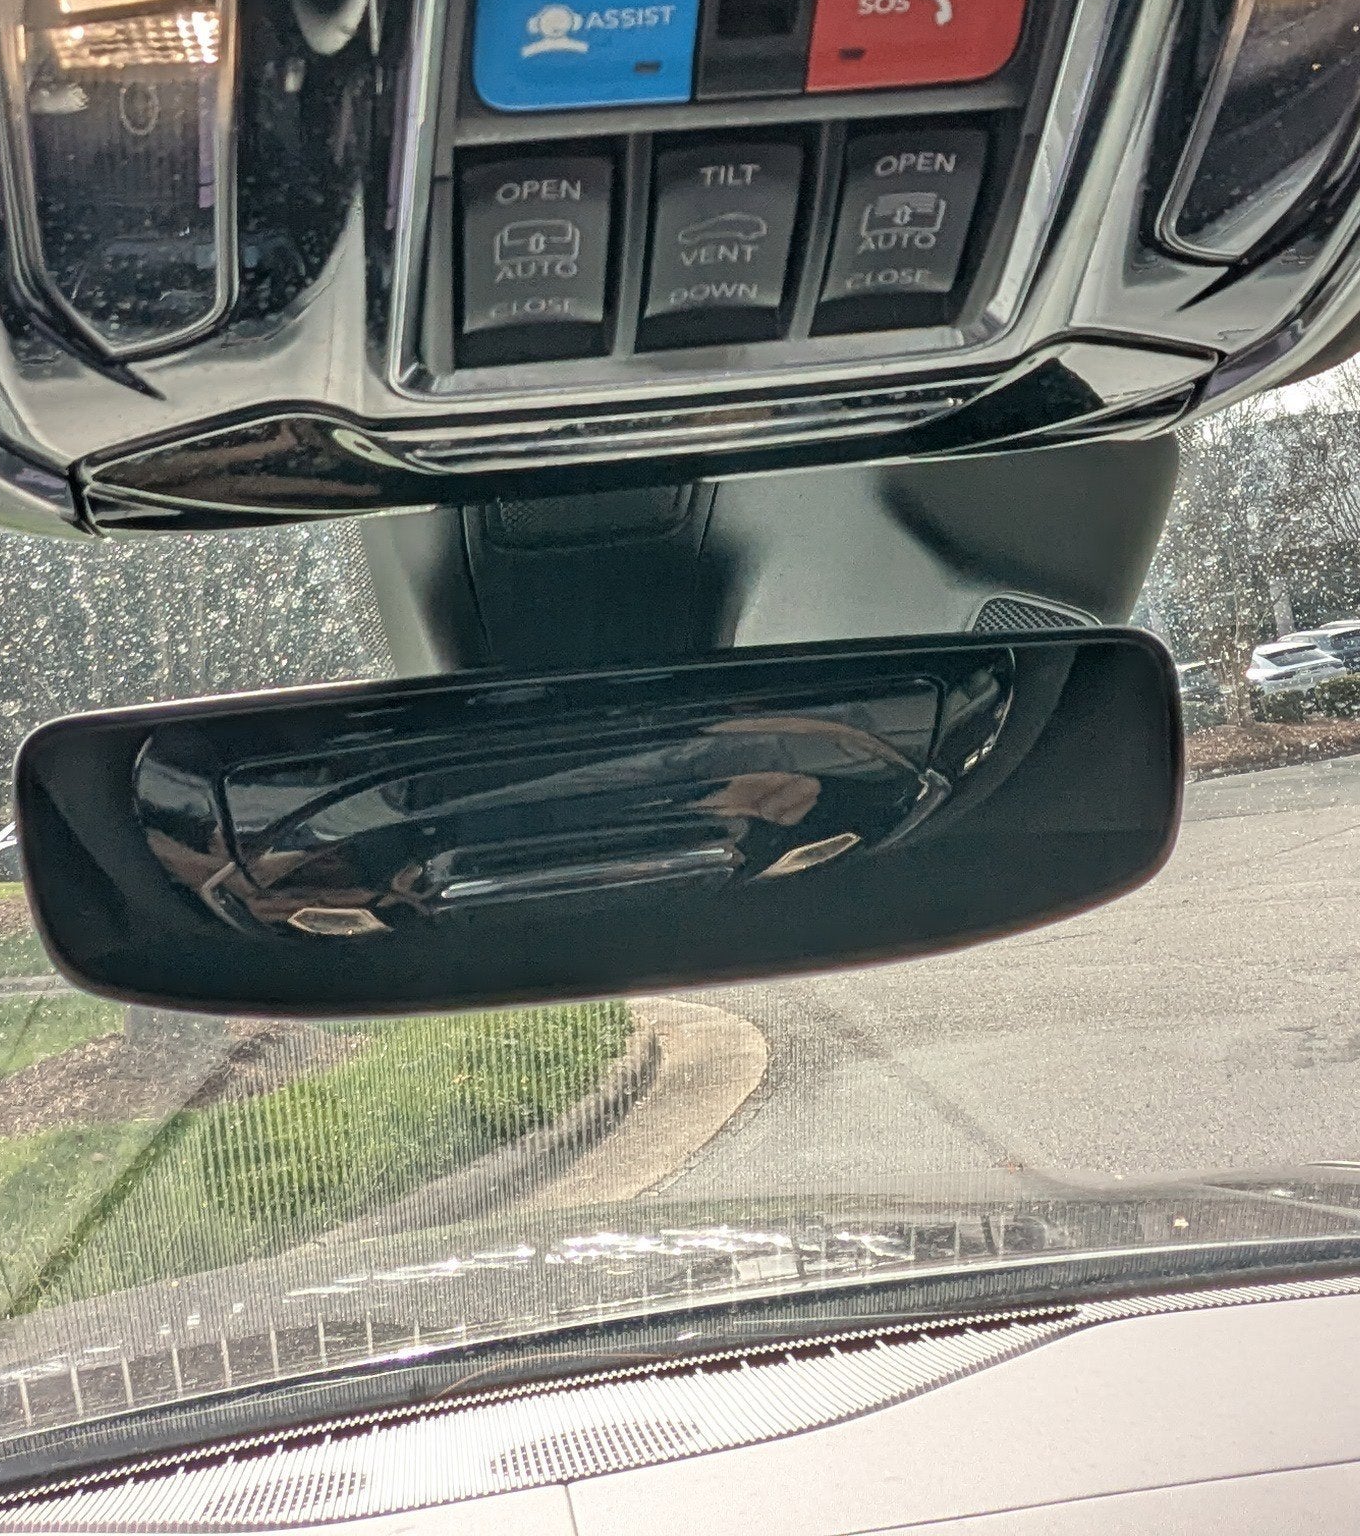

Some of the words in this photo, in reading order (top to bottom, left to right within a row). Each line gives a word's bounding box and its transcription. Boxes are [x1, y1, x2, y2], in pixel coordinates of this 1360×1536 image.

[585, 5, 676, 30] ASSIST
[699, 164, 761, 186] TILT
[875, 152, 957, 177] OPEN
[495, 178, 582, 204] OPEN
[858, 231, 937, 254] AUTO
[679, 245, 759, 266] VENT
[495, 262, 579, 283] AUTO
[845, 268, 931, 291] CLOSE
[668, 283, 760, 305] DOWN
[490, 298, 572, 319] CLOSE
